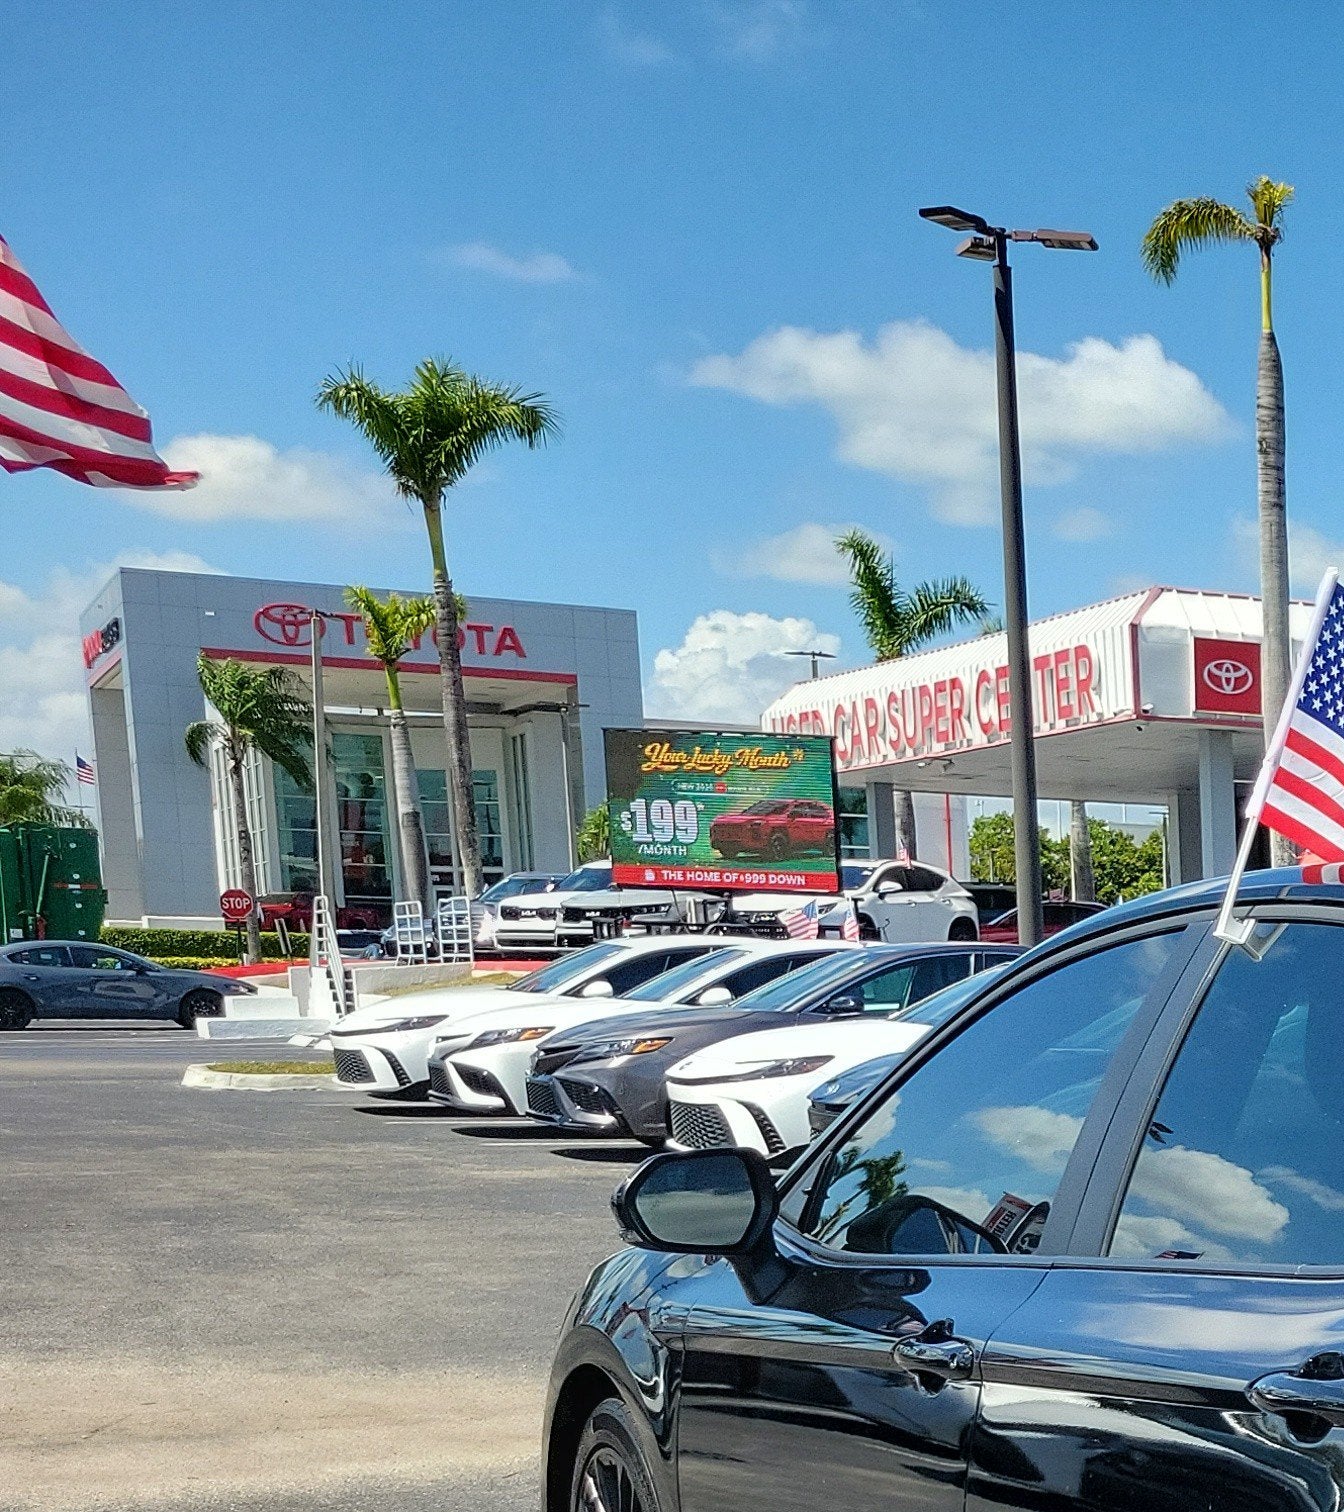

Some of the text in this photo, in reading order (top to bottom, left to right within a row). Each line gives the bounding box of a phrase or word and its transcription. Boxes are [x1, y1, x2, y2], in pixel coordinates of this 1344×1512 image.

[336, 613, 527, 659] TTA
[834, 643, 1096, 762] CAR SUPER CETER
[641, 742, 792, 776] Your Lucky Month
[661, 870, 684, 881] THE
[686, 870, 721, 882] HOME
[723, 871, 739, 883] OF
[768, 872, 806, 886] DOWN
[221, 896, 251, 910] STOP
